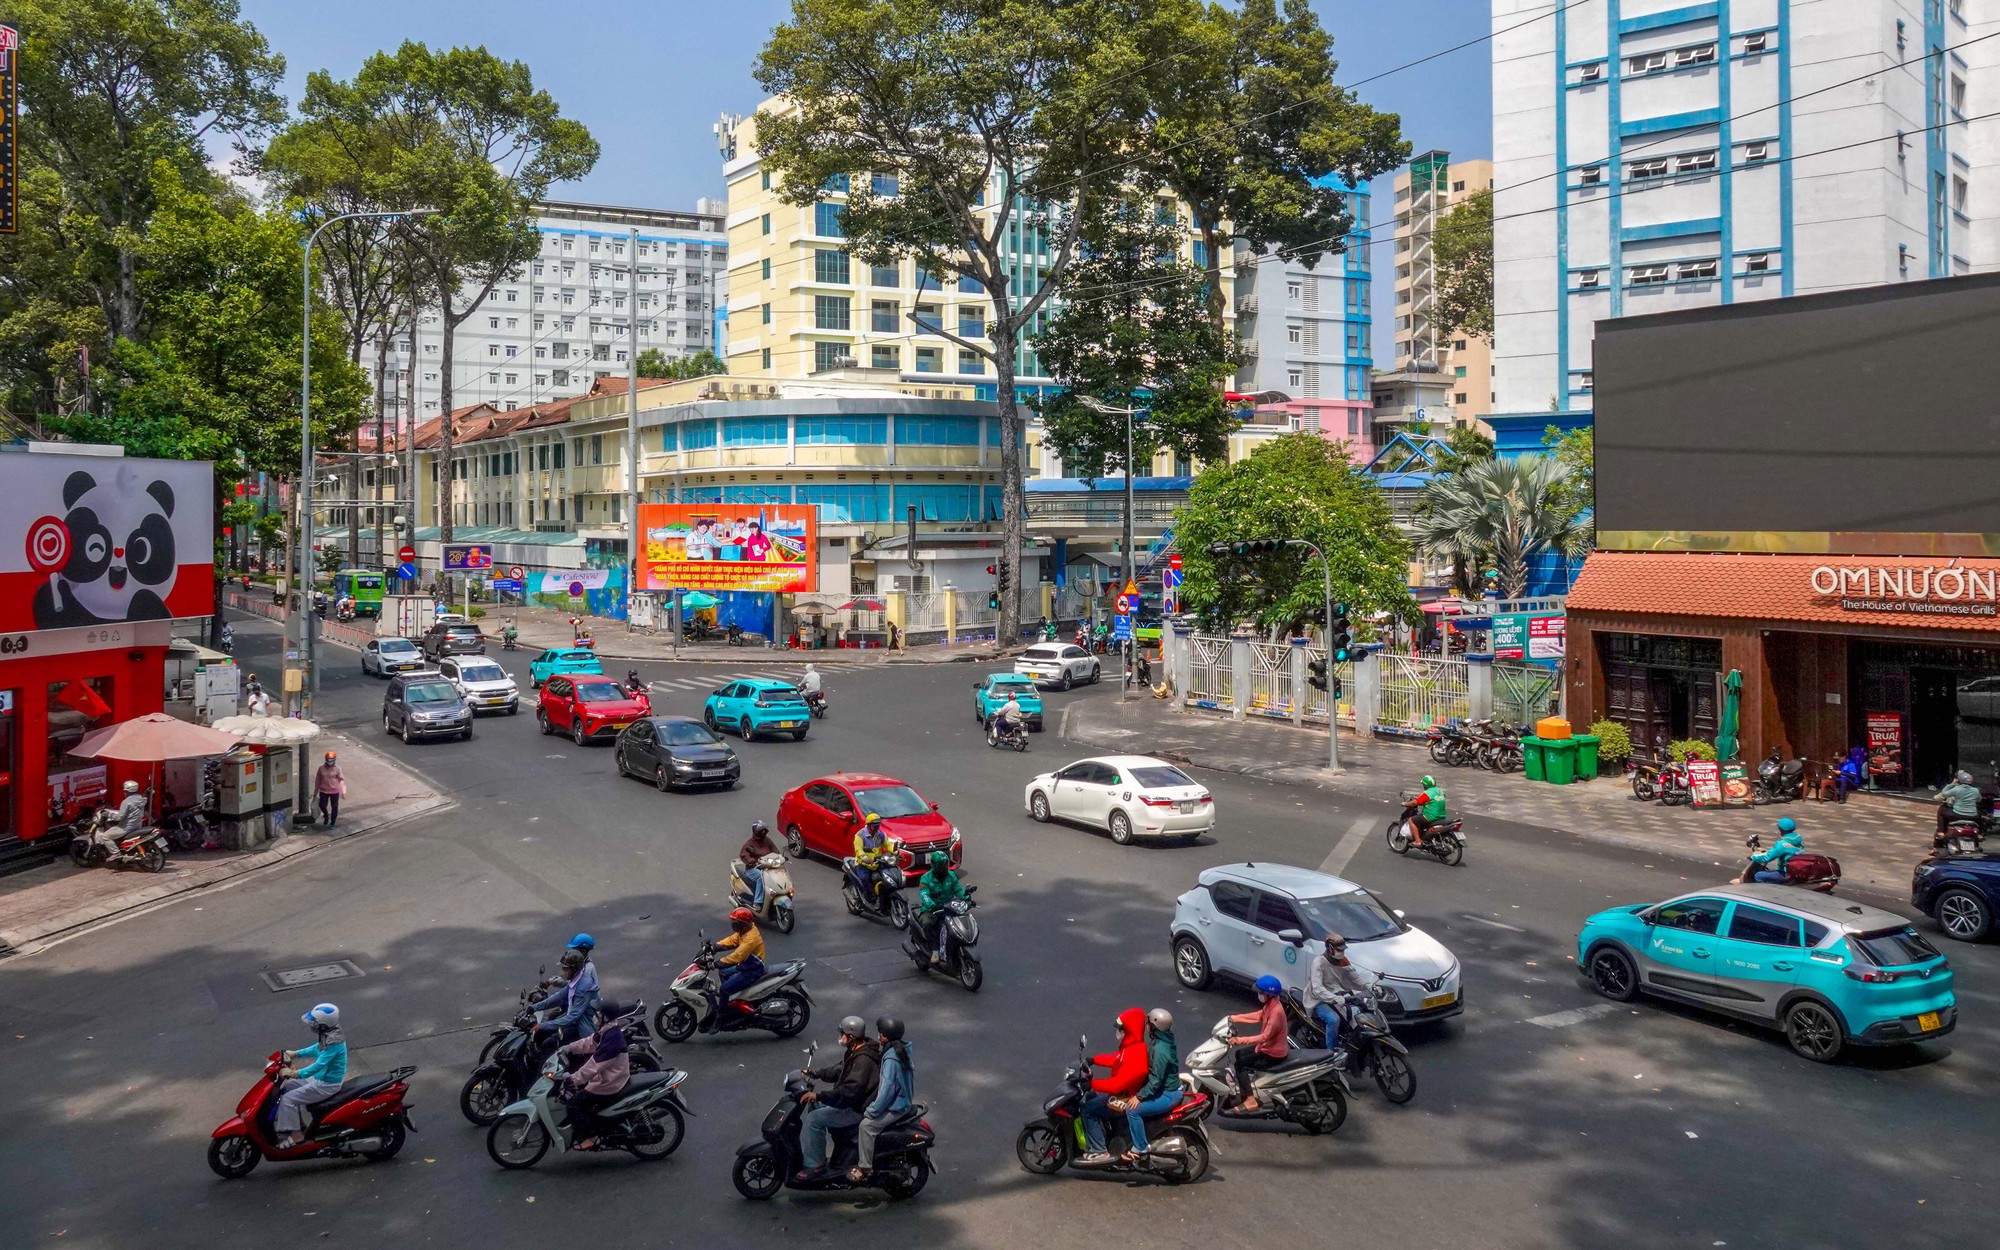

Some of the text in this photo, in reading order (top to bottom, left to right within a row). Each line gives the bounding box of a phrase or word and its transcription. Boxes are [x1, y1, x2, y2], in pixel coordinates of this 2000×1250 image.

[1417, 409, 1425, 419] G
[1879, 559, 2000, 600] NƯỚN
[1842, 600, 1996, 615] The House of Vietnamese Grills
